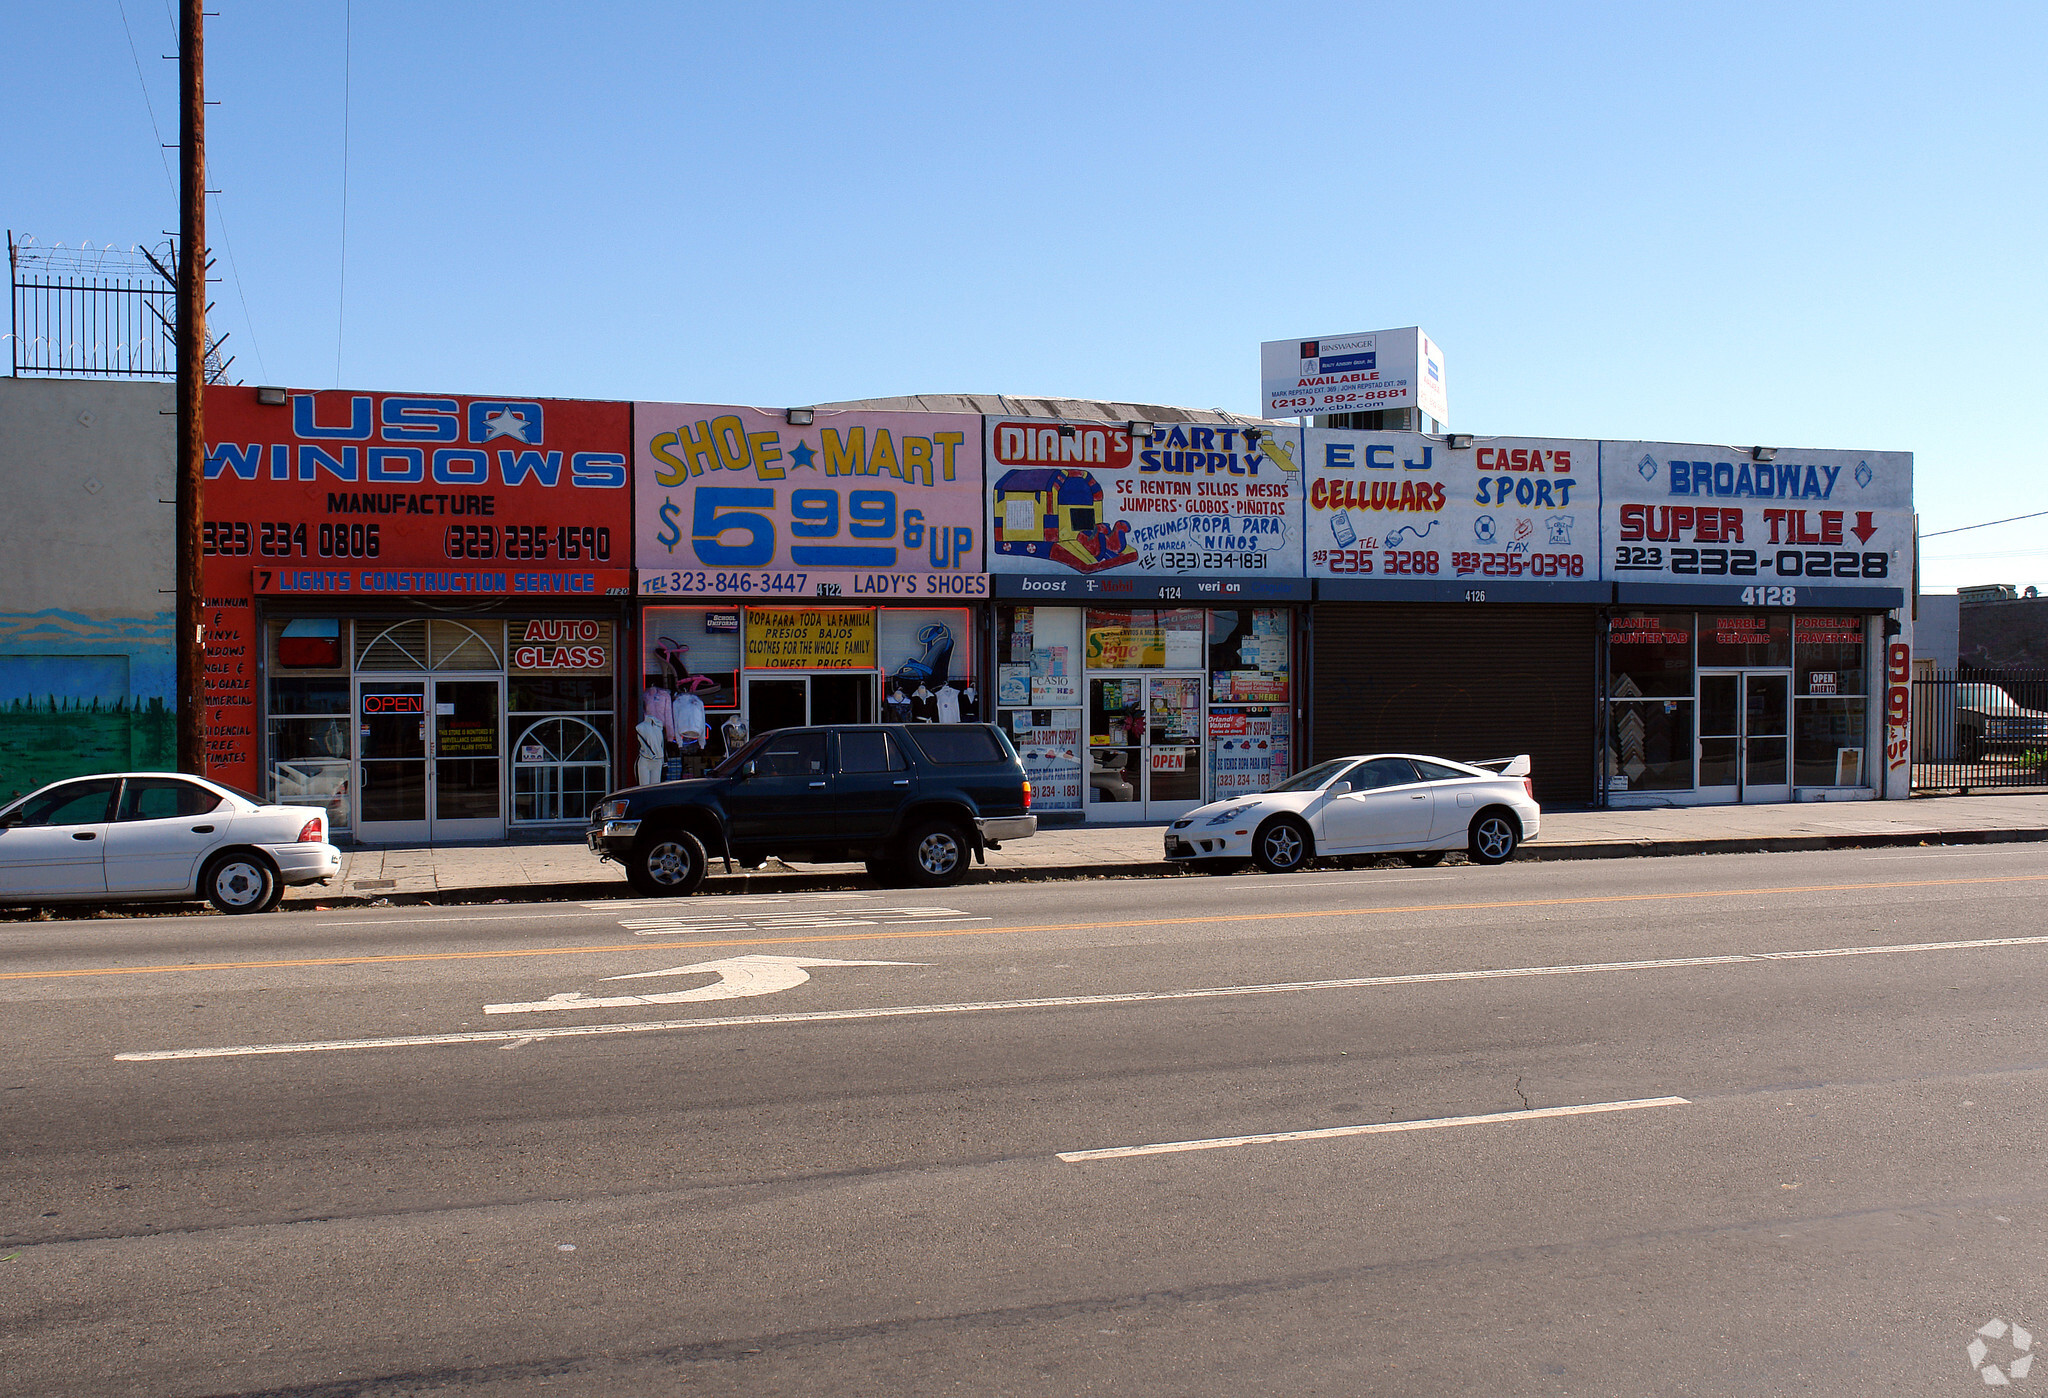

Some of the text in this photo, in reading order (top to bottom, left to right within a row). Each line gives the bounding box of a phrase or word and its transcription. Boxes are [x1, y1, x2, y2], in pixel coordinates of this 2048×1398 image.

[1322, 341, 1372, 351] BINSWANGER
[1298, 372, 1380, 387] AVAILABLE
[1271, 389, 1287, 398] MARK
[1288, 387, 1314, 396] REPSTAD
[1341, 384, 1357, 392] JOHN
[1357, 382, 1383, 390] REPSTAD
[1271, 396, 1315, 409] (213)
[1324, 388, 1407, 404] 892-8881
[1294, 401, 1384, 414] www.cbb.com
[293, 396, 544, 447] USA
[1001, 427, 1128, 463] DIANA'S
[1142, 424, 1261, 453] PARTY
[649, 415, 965, 488] SHOE MART
[204, 443, 627, 489] WINDOWS
[1139, 450, 1263, 477] SUPPLY
[1475, 447, 1572, 473] CASA'S
[1668, 460, 1841, 500] BROADWAY
[1115, 479, 1289, 498] SE RENTAN SILLAS MESAS
[1310, 477, 1447, 513] CELLULARS
[1474, 476, 1578, 510] SPORT
[327, 493, 496, 516] MANUFACTURE
[1119, 497, 1286, 516] JUMPERS GLOBOS PIÑATAS
[1191, 516, 1280, 534] ROPA PARA
[1620, 504, 1844, 545] SUPER TILE
[203, 521, 380, 558] 323) 234 0806
[443, 525, 500, 561] (323)
[902, 508, 925, 550] &
[929, 526, 974, 570] UP
[1143, 542, 1155, 551] DE
[1204, 534, 1258, 551] NIÑOS
[1358, 536, 1380, 549] TEL
[1505, 541, 1529, 554] FAX
[1138, 552, 1157, 569] TEL
[1160, 552, 1200, 569] (323)
[1312, 549, 1441, 575] 323 235 3288
[1615, 546, 1889, 579] 323 232-0228
[259, 571, 595, 593] 7 LIGHTS CONSTRUCTION SERVICE
[642, 572, 808, 595] TEL 323-846-3447
[853, 574, 987, 595] LADY'S SHOES
[1022, 577, 1067, 592] boost
[605, 586, 630, 596] 4120
[817, 583, 842, 597] 4122
[1158, 586, 1182, 600] 4124
[1465, 590, 1486, 602] 4126
[1740, 586, 1797, 606] 4128
[205, 598, 249, 609] UMINUM
[749, 612, 870, 627] ROPA PARA TODA LA FAMILIA
[1717, 618, 1766, 629] MARBLE
[1795, 618, 1860, 629] PORCELAIN
[204, 630, 241, 641] INYL
[524, 620, 600, 641] AUTO
[765, 628, 853, 639] PRESIOS BAJOS
[1665, 633, 1688, 644] TAB
[1716, 633, 1771, 644] CERAMIC
[1794, 633, 1864, 644] TRAVERTINE
[206, 646, 246, 657] NDOWS
[749, 640, 870, 654] CLOTHES FOR THE WHOLE FAMILY
[1086, 632, 1139, 664] Sigue
[515, 646, 606, 669] GLASS
[765, 658, 853, 667] LOWEST PRICES
[205, 663, 230, 674] NGLE
[218, 679, 251, 690] GLAZE
[1036, 677, 1069, 686] CASIO
[1812, 673, 1834, 684] OPEN
[1032, 687, 1075, 695] WATHES
[1811, 685, 1836, 693] ABIERTO
[365, 697, 423, 712] OPEN
[1259, 693, 1280, 701] HERE!
[1887, 739, 1908, 762] UP
[1153, 754, 1183, 769] OPEN
[1217, 774, 1250, 788] (323) 234
[1042, 785, 1055, 798] 234
[1063, 785, 1080, 798] 1831
